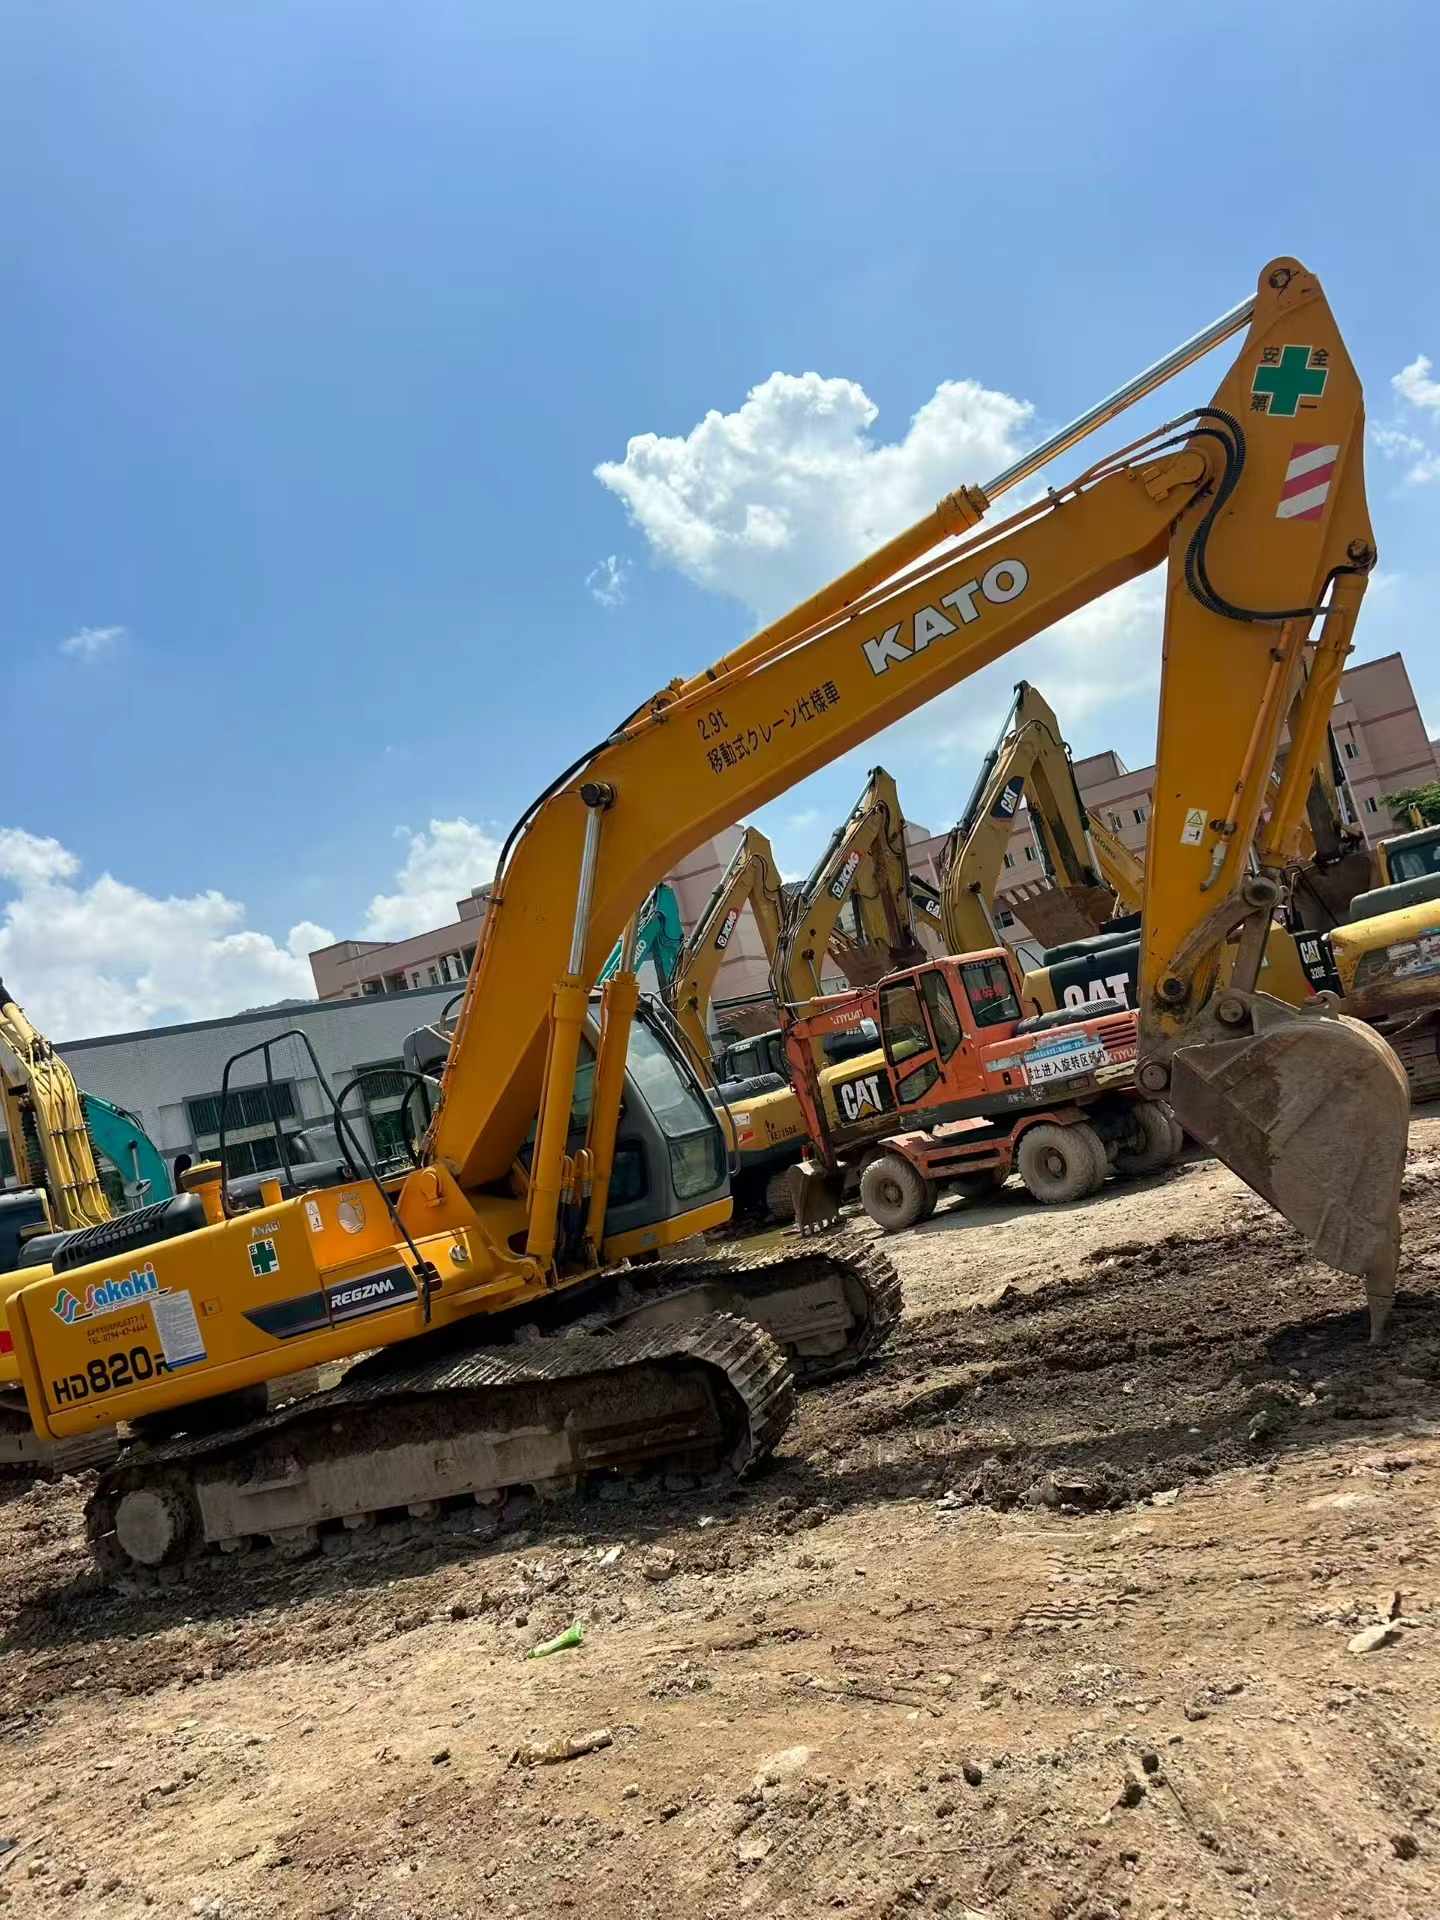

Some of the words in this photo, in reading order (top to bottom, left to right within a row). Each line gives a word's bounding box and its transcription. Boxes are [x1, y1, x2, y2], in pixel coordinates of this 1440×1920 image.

[861, 559, 1030, 676] KATO
[697, 708, 728, 741] 2.9t
[706, 680, 840, 775] 移動式クレーン仕様車
[1000, 785, 1019, 815] CAT
[925, 899, 941, 918] CA
[1300, 940, 1321, 964] CAT
[841, 1075, 883, 1121] CAT
[84, 1262, 159, 1312] Sakaki
